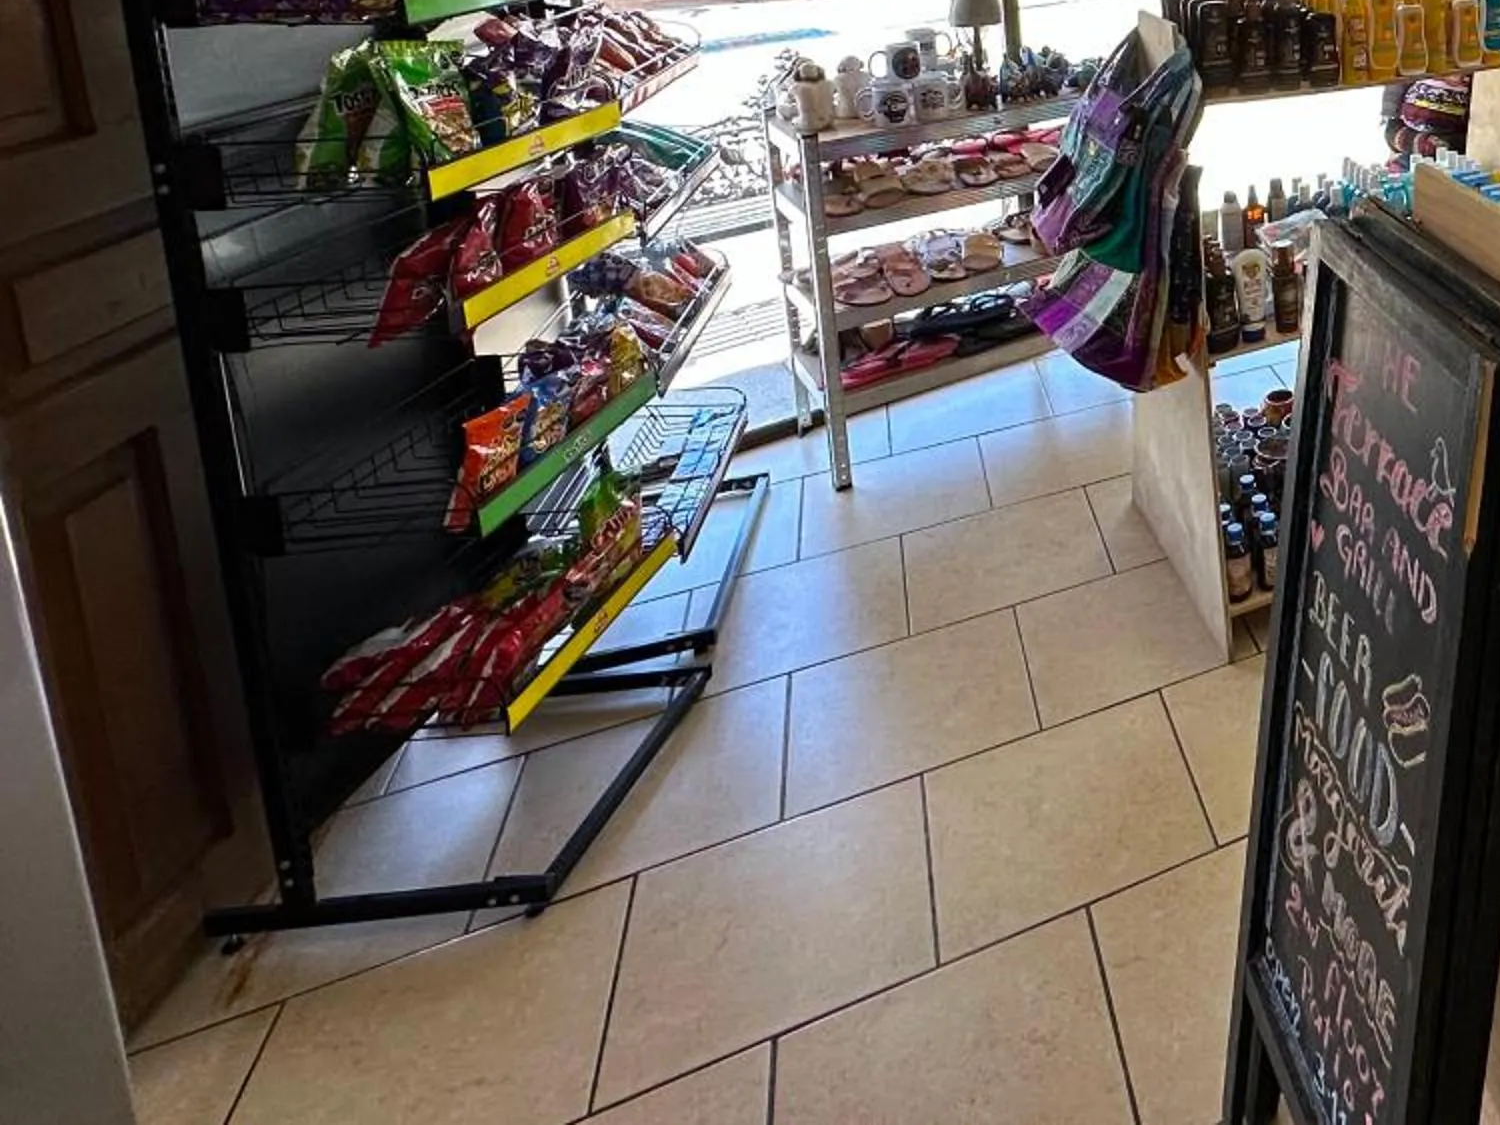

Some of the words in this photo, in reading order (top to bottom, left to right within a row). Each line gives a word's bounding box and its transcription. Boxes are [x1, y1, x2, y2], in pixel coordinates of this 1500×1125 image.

[1319, 444, 1376, 545] BAR
[1381, 527, 1438, 625] AND
[1335, 523, 1395, 636] GRILL
[1308, 569, 1373, 707] BEER
